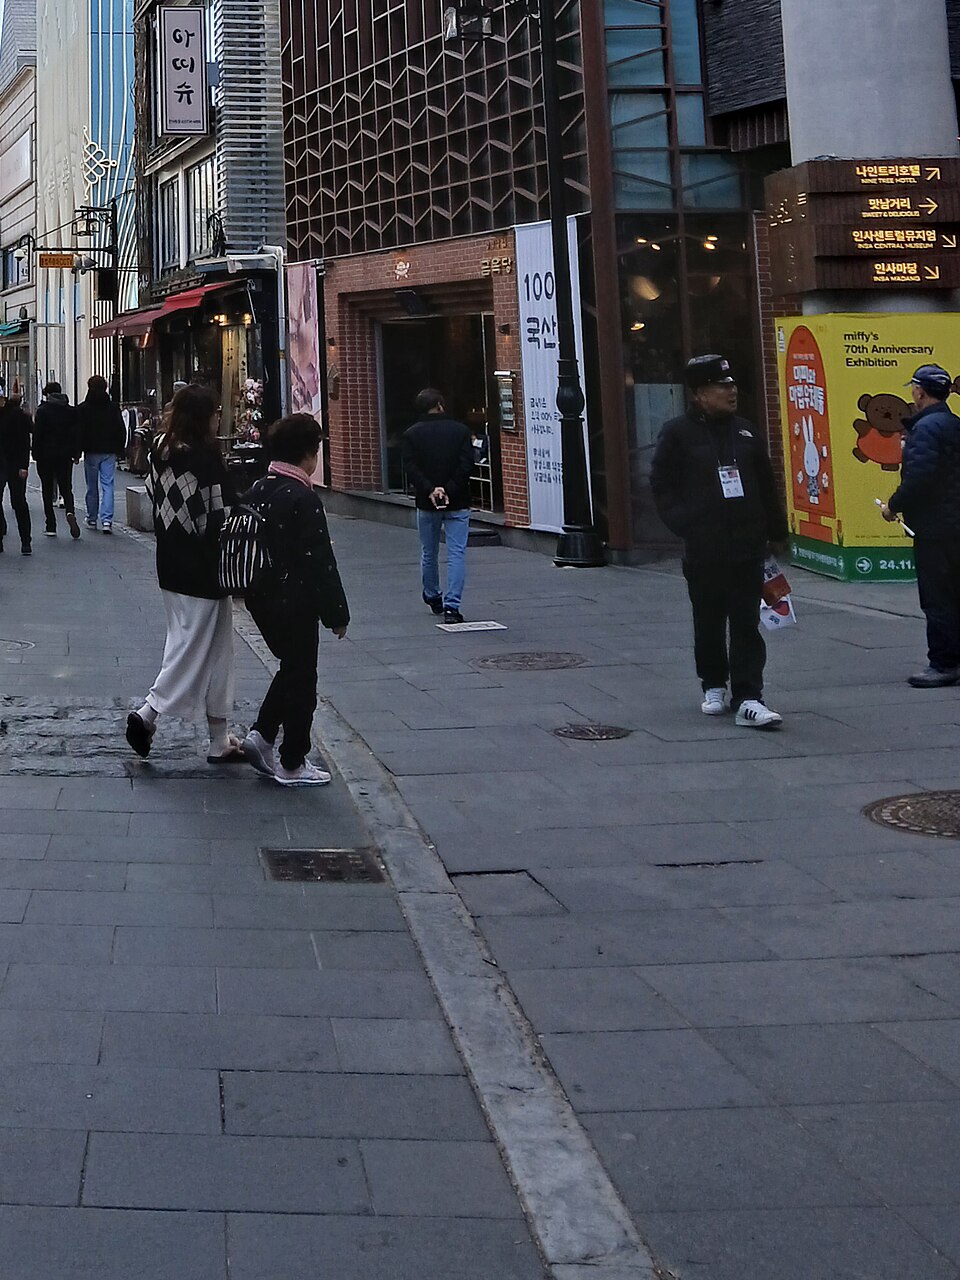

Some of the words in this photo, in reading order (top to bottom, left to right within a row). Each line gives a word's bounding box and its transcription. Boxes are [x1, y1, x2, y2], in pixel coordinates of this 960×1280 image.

[171, 28, 196, 106] 아띠슈
[855, 164, 921, 177] 나인트리호텔
[868, 197, 911, 210] 맛남거리
[852, 229, 937, 242] 인사센트럴뮤지엄
[481, 257, 513, 276] 금옥당
[874, 262, 918, 275] 인사마당
[524, 271, 555, 301] 100
[526, 314, 557, 349] 국산
[843, 331, 879, 343] miffy's
[844, 344, 869, 354] 70th
[871, 344, 934, 356] Anniversary
[845, 357, 898, 367] Exhibition
